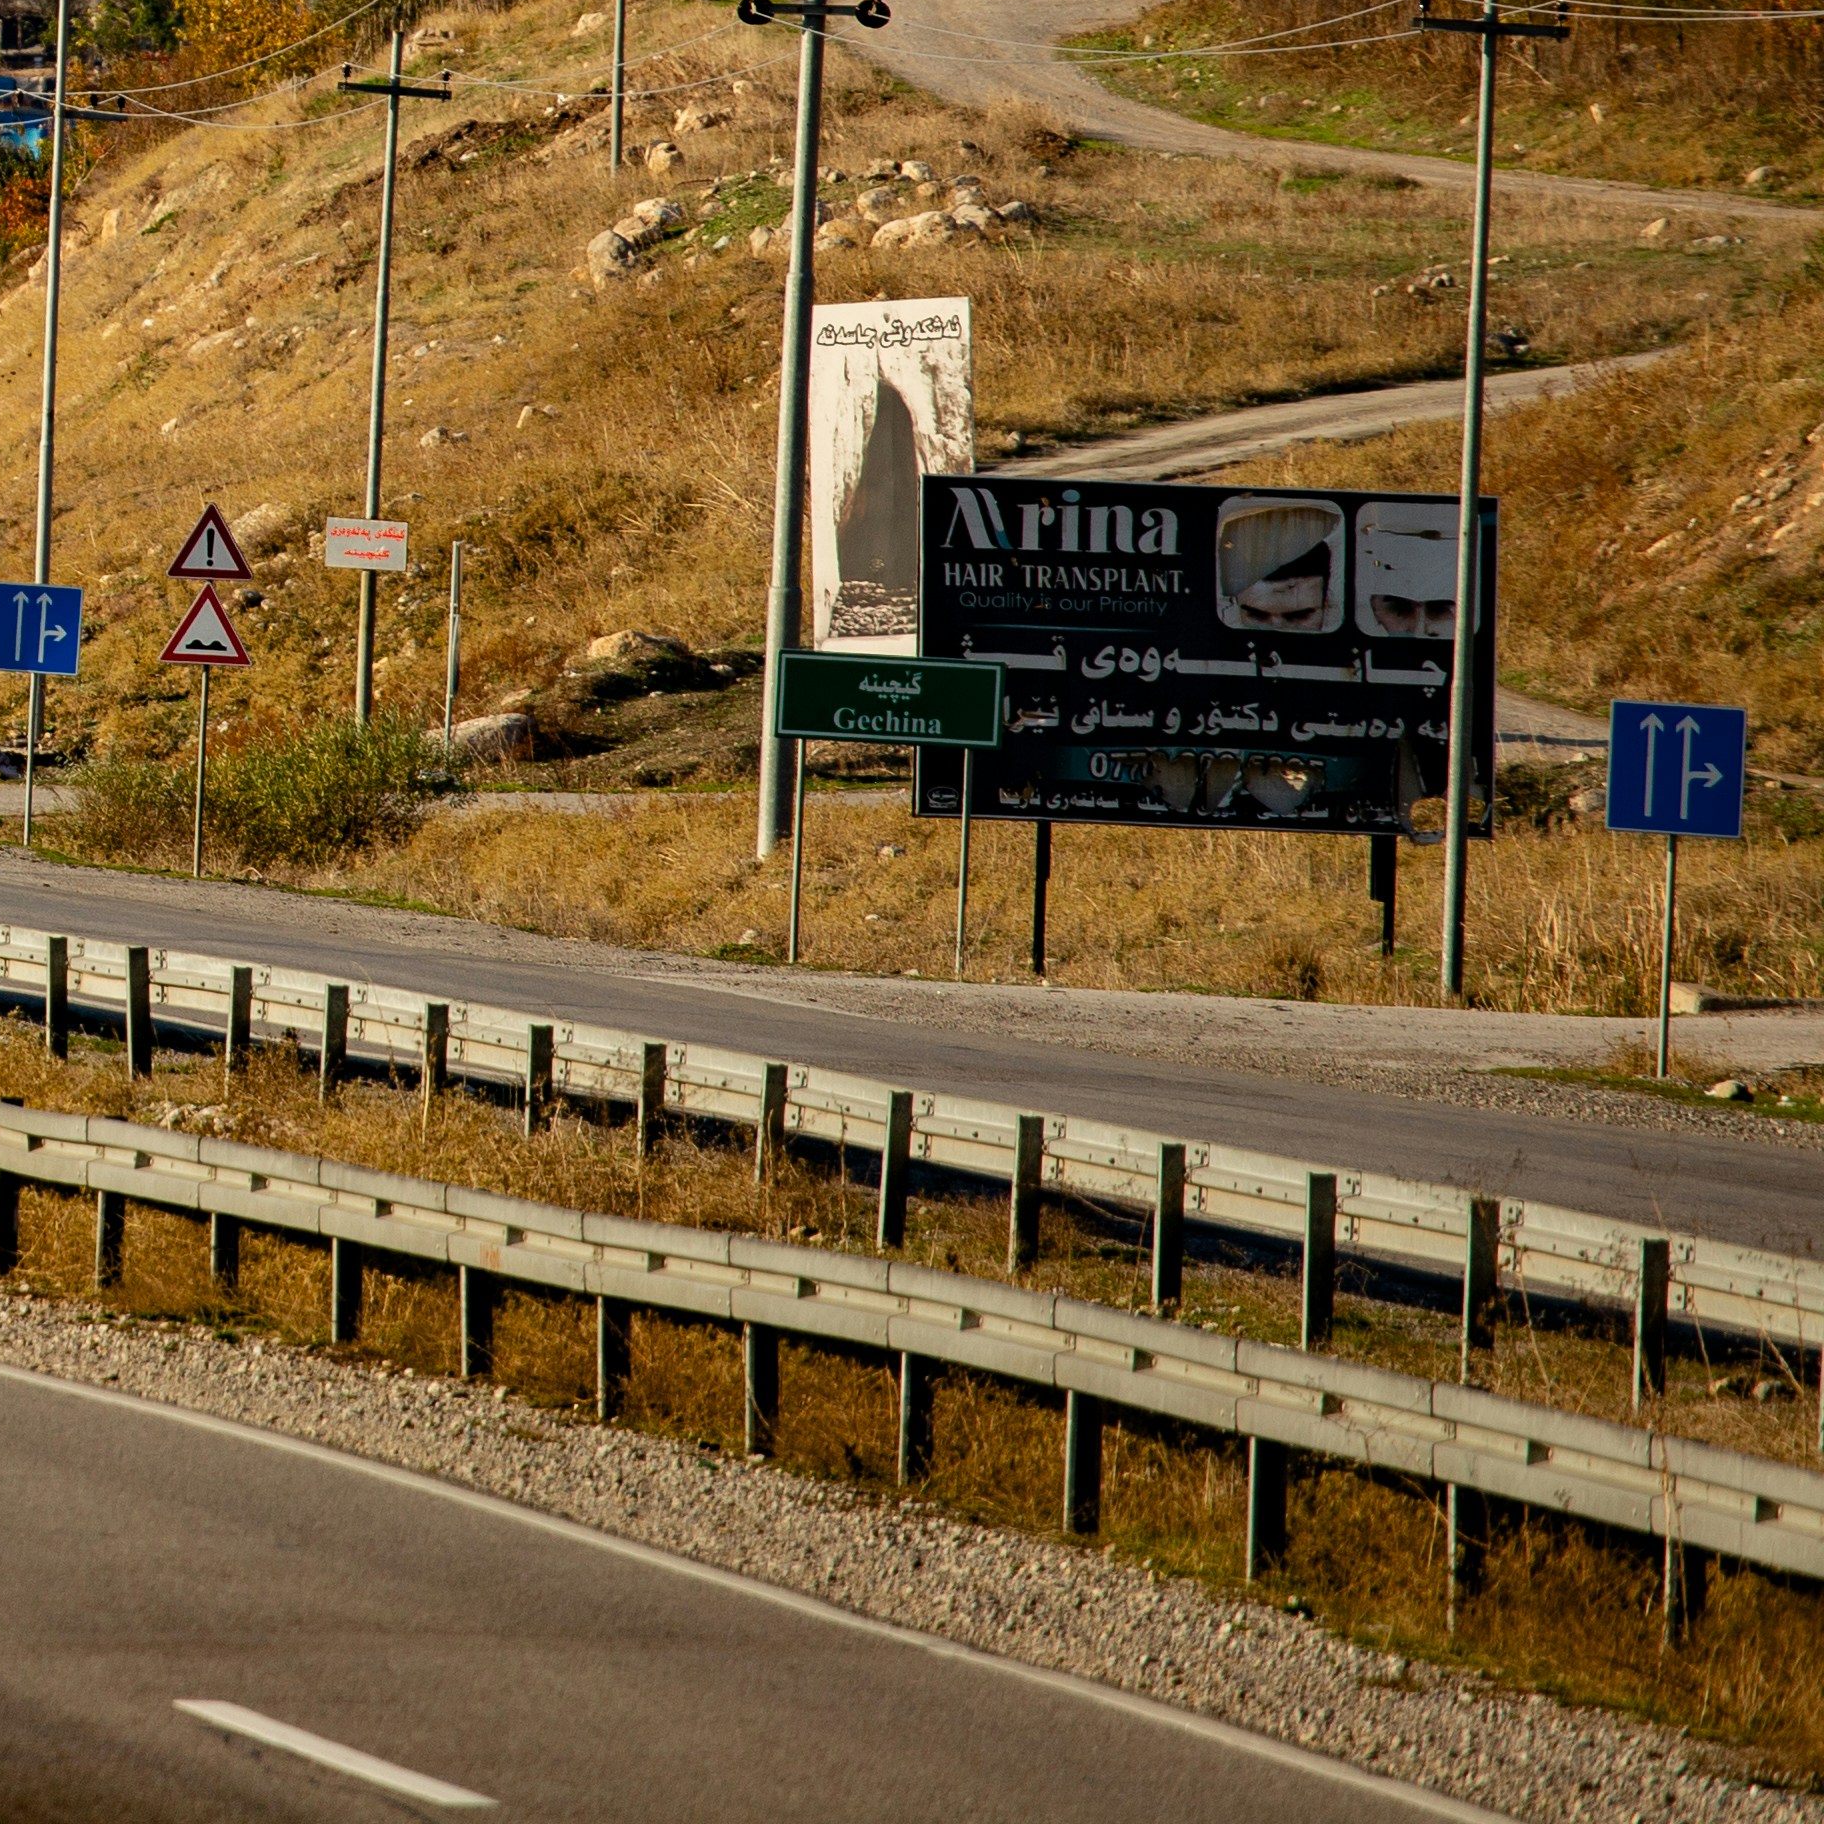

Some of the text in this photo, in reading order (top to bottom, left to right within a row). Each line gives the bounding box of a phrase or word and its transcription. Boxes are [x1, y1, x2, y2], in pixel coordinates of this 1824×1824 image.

[939, 486, 1183, 556] Arina
[943, 562, 1191, 595] HAIR TRANSPLANT.
[958, 590, 1169, 617] Quality is our Priority
[833, 707, 943, 735] Gechina
